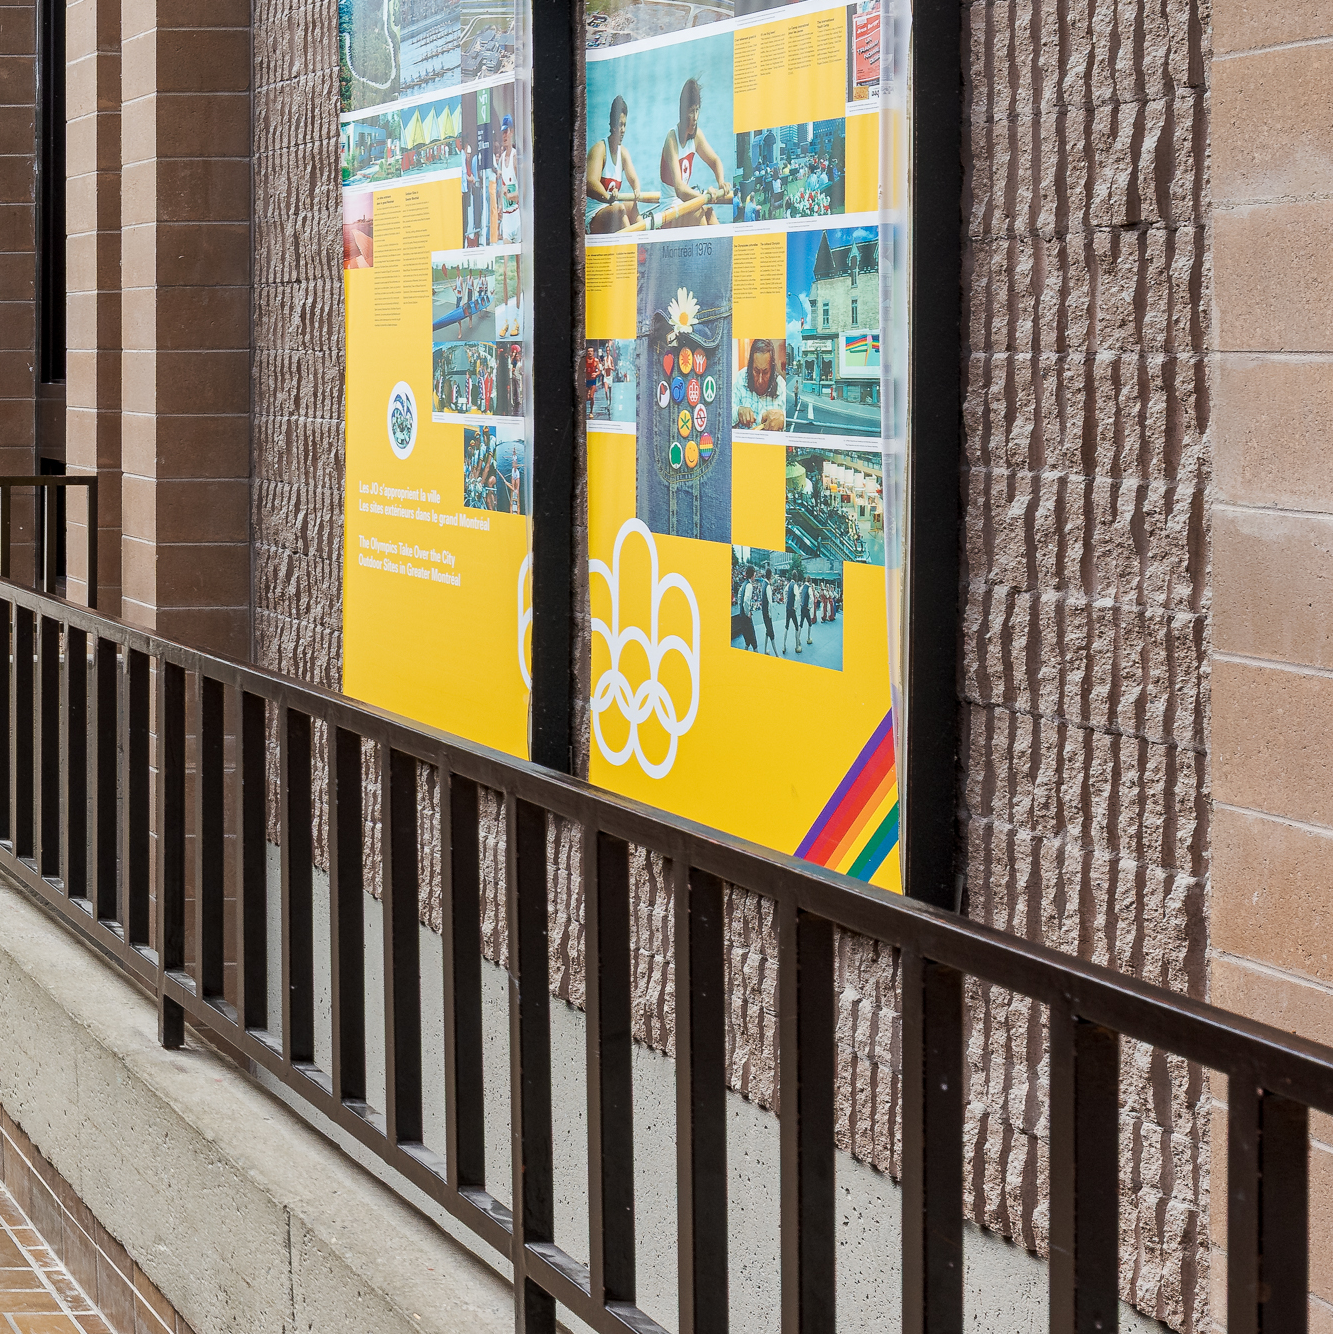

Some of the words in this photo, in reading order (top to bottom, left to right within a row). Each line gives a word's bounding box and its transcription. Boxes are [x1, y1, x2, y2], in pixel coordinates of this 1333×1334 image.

[662, 243, 694, 259] Montréal
[695, 242, 713, 256] 1976
[358, 480, 370, 494] Les
[369, 481, 379, 495] JO
[420, 488, 427, 502] la
[427, 489, 441, 504] ville
[358, 498, 370, 512] Les
[369, 501, 384, 515] sites
[384, 503, 415, 520] extérieurs
[415, 507, 431, 522] dans
[431, 509, 438, 523] le
[438, 512, 458, 527] grand
[459, 512, 490, 532] Montréal
[358, 534, 370, 549] The
[370, 537, 398, 555] Olympics
[398, 541, 413, 557] Take
[413, 545, 429, 560] Over
[429, 548, 441, 563] the
[441, 550, 456, 569] City
[358, 553, 382, 570] Outdoor
[383, 557, 399, 574] Sites
[399, 561, 406, 575] in
[406, 562, 430, 580] Greater
[431, 567, 461, 587] Montréal
